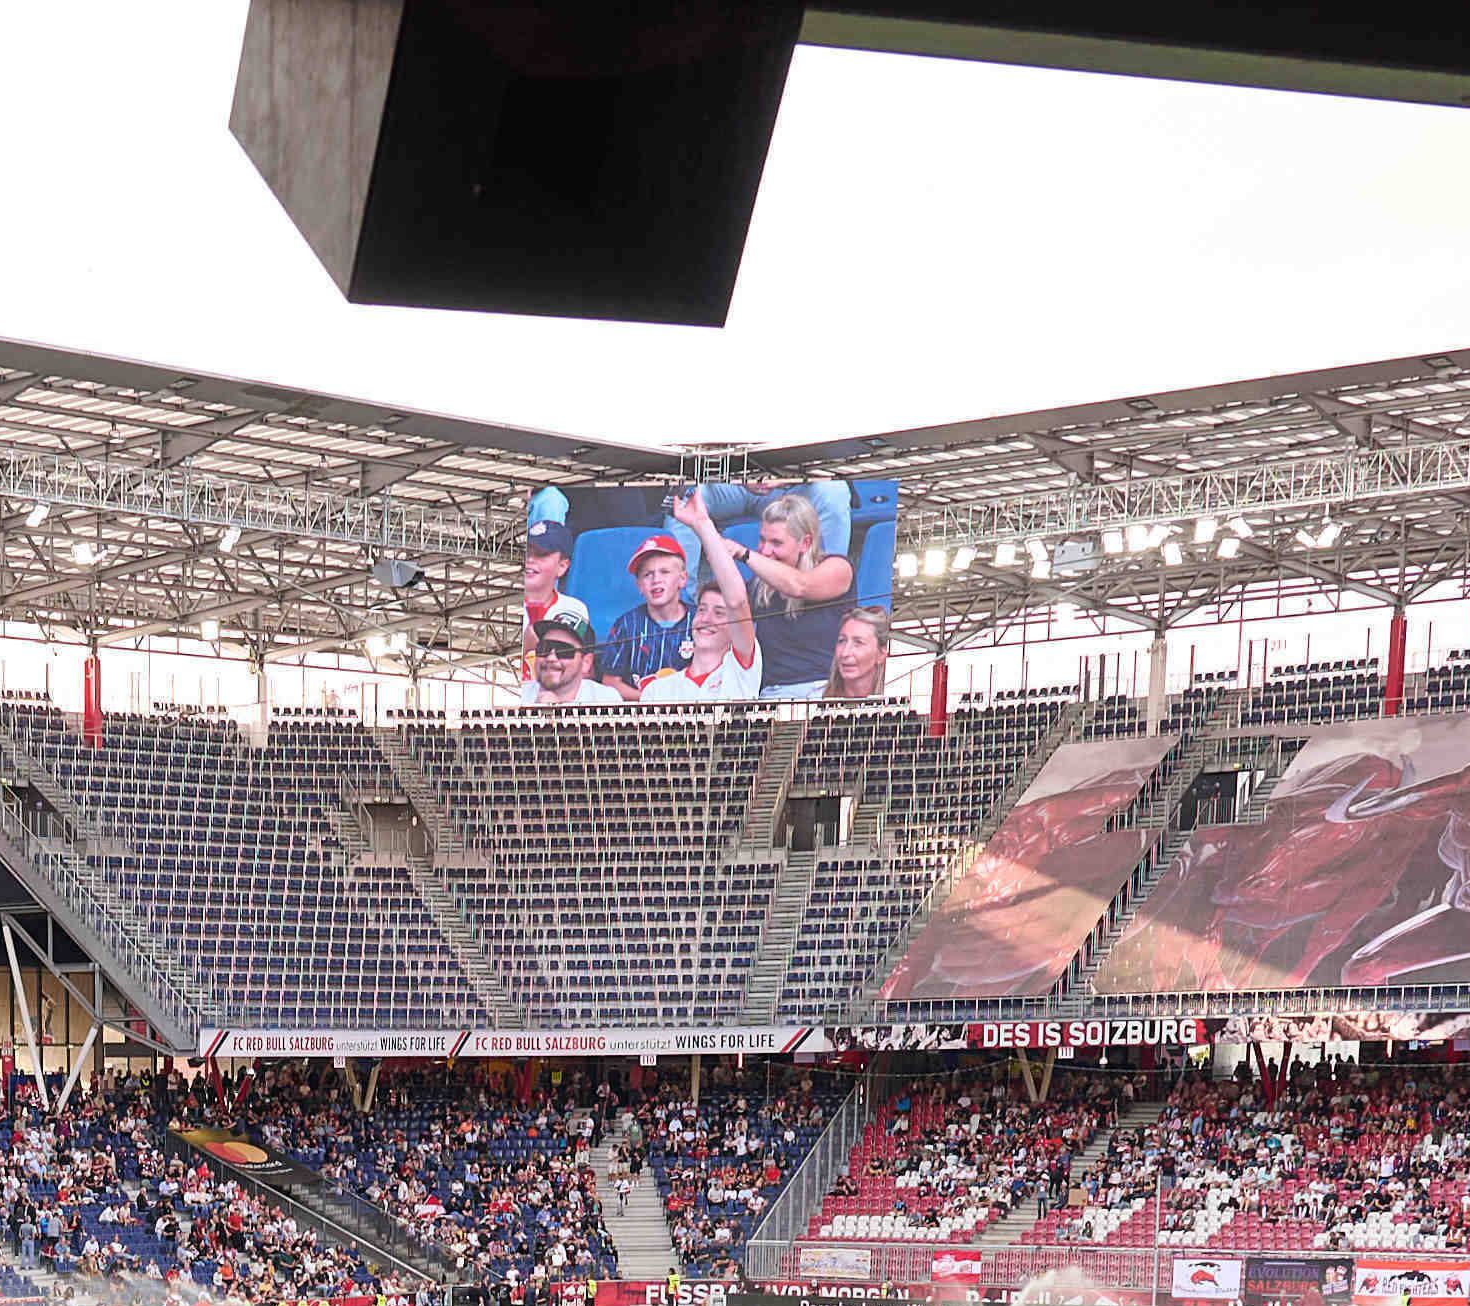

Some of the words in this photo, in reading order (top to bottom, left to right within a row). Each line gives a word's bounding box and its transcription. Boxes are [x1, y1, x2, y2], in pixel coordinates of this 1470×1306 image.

[983, 1022, 1029, 1048] DES
[1035, 1021, 1060, 1047] IS
[1068, 1018, 1197, 1046] SOIZBURG
[233, 1037, 244, 1052] FC
[246, 1037, 263, 1052] RED
[266, 1037, 286, 1052] BULL
[289, 1037, 334, 1052] SALZBURG
[380, 1037, 408, 1052] WINGS
[409, 1037, 426, 1052] FOR
[428, 1037, 446, 1052] LIFE
[475, 1037, 488, 1051] FC
[491, 1037, 512, 1051] RED
[515, 1037, 542, 1051] BULL
[545, 1037, 606, 1051] SALZBURG
[674, 1036, 715, 1050] WINGS
[719, 1036, 745, 1050] FOR
[748, 1036, 775, 1050] LIFE
